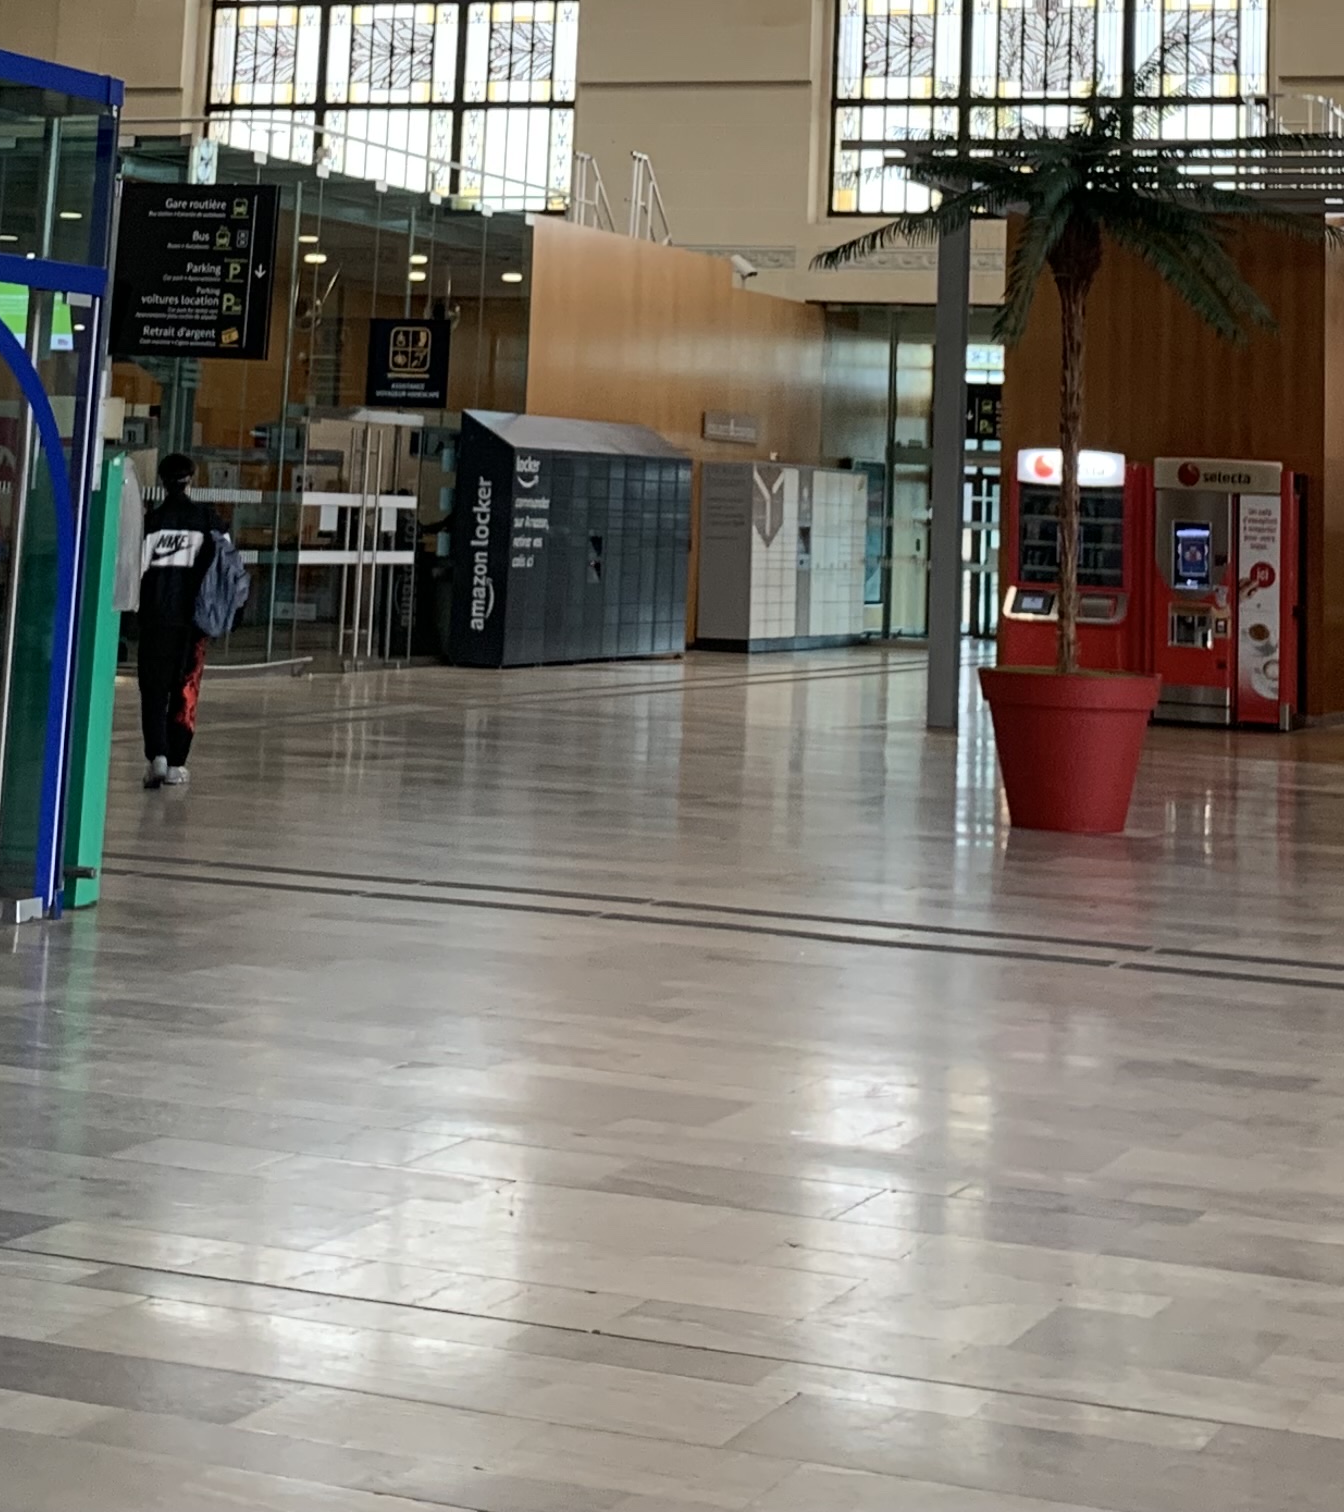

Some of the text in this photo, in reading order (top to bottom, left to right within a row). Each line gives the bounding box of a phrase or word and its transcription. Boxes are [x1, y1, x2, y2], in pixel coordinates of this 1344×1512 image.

[165, 197, 227, 210] Gare routière
[192, 230, 210, 242] Bus
[186, 262, 221, 276] Parking
[141, 293, 219, 306] voitures location
[143, 324, 216, 340] Retrait d'argent
[1203, 471, 1251, 485] selecta
[156, 534, 188, 549] NIKE
[470, 476, 492, 631] amazon locker
